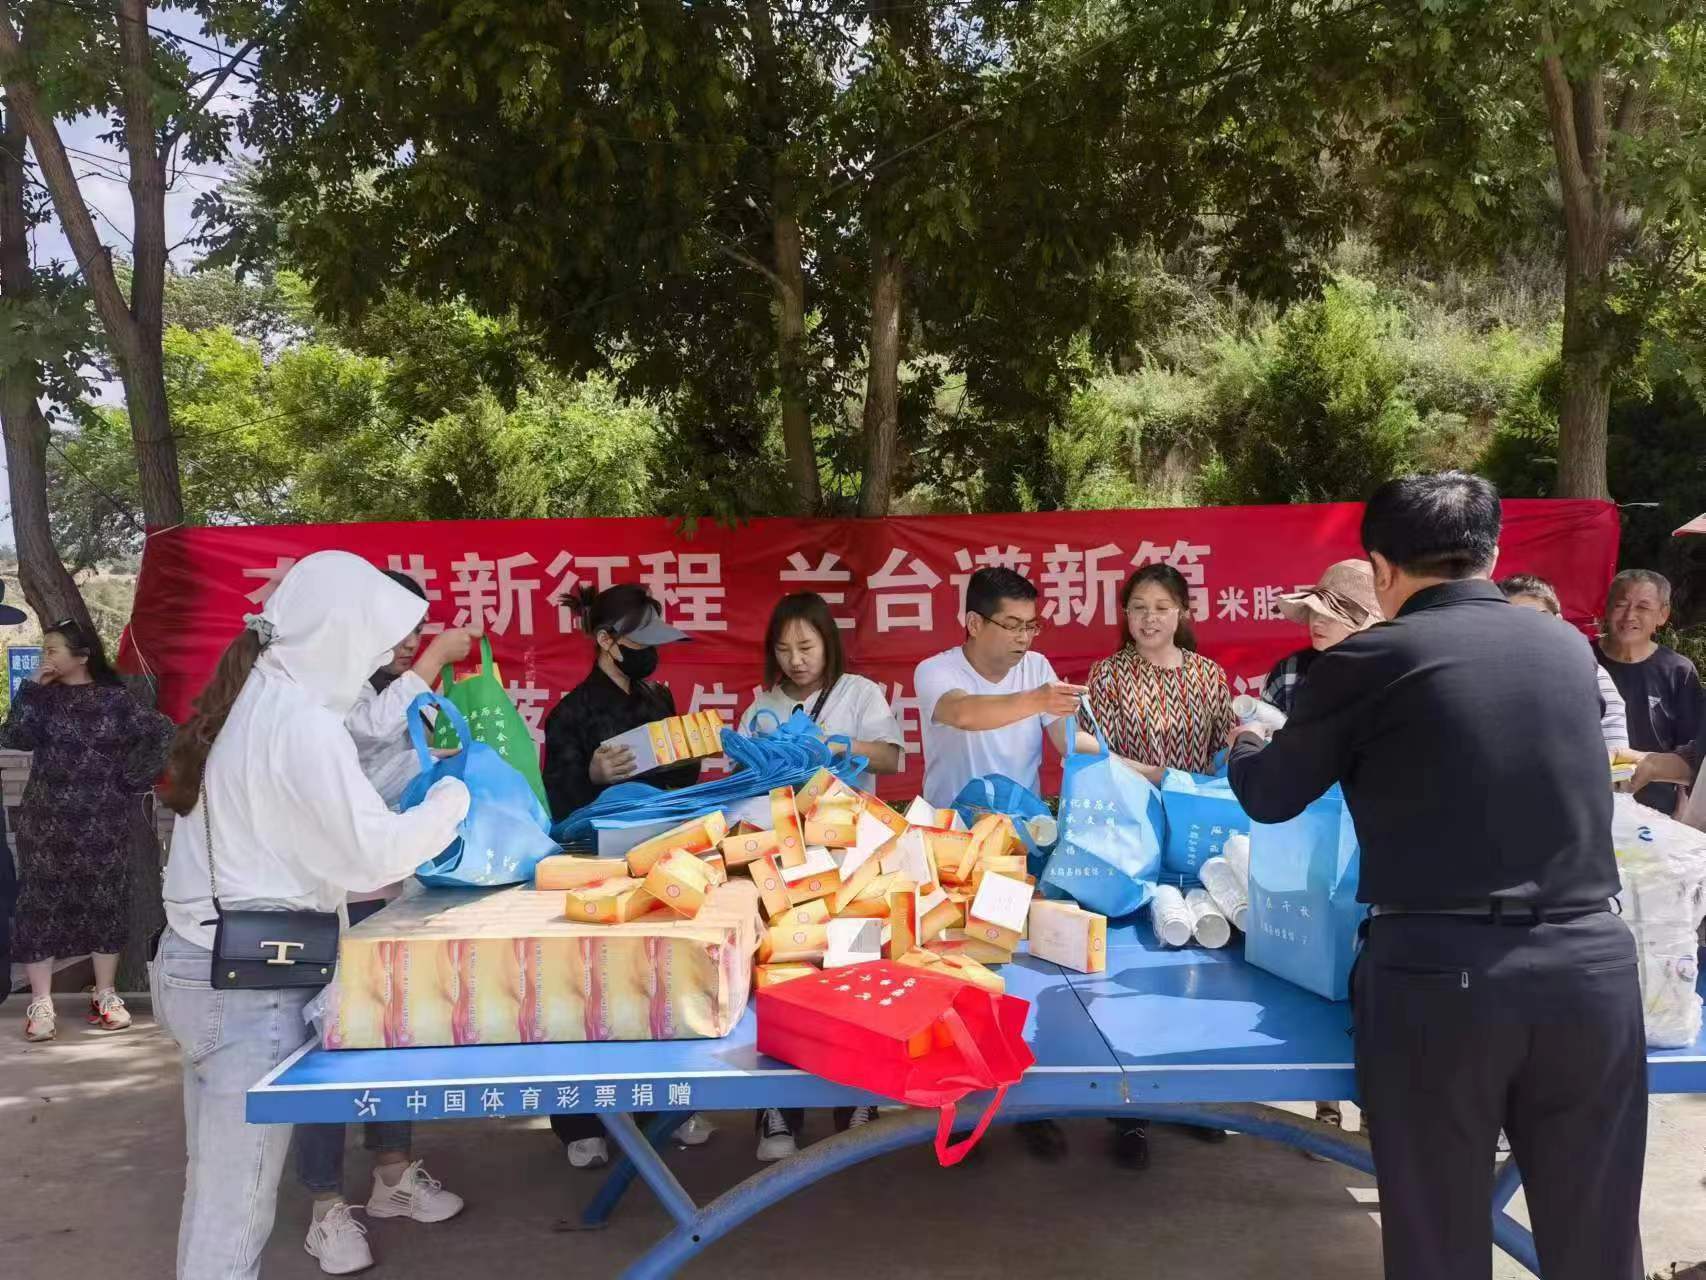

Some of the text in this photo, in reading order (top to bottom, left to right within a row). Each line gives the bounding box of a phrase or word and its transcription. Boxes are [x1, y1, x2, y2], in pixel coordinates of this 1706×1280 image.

[405, 1081, 692, 1115] 中国体育彩票捐赠
